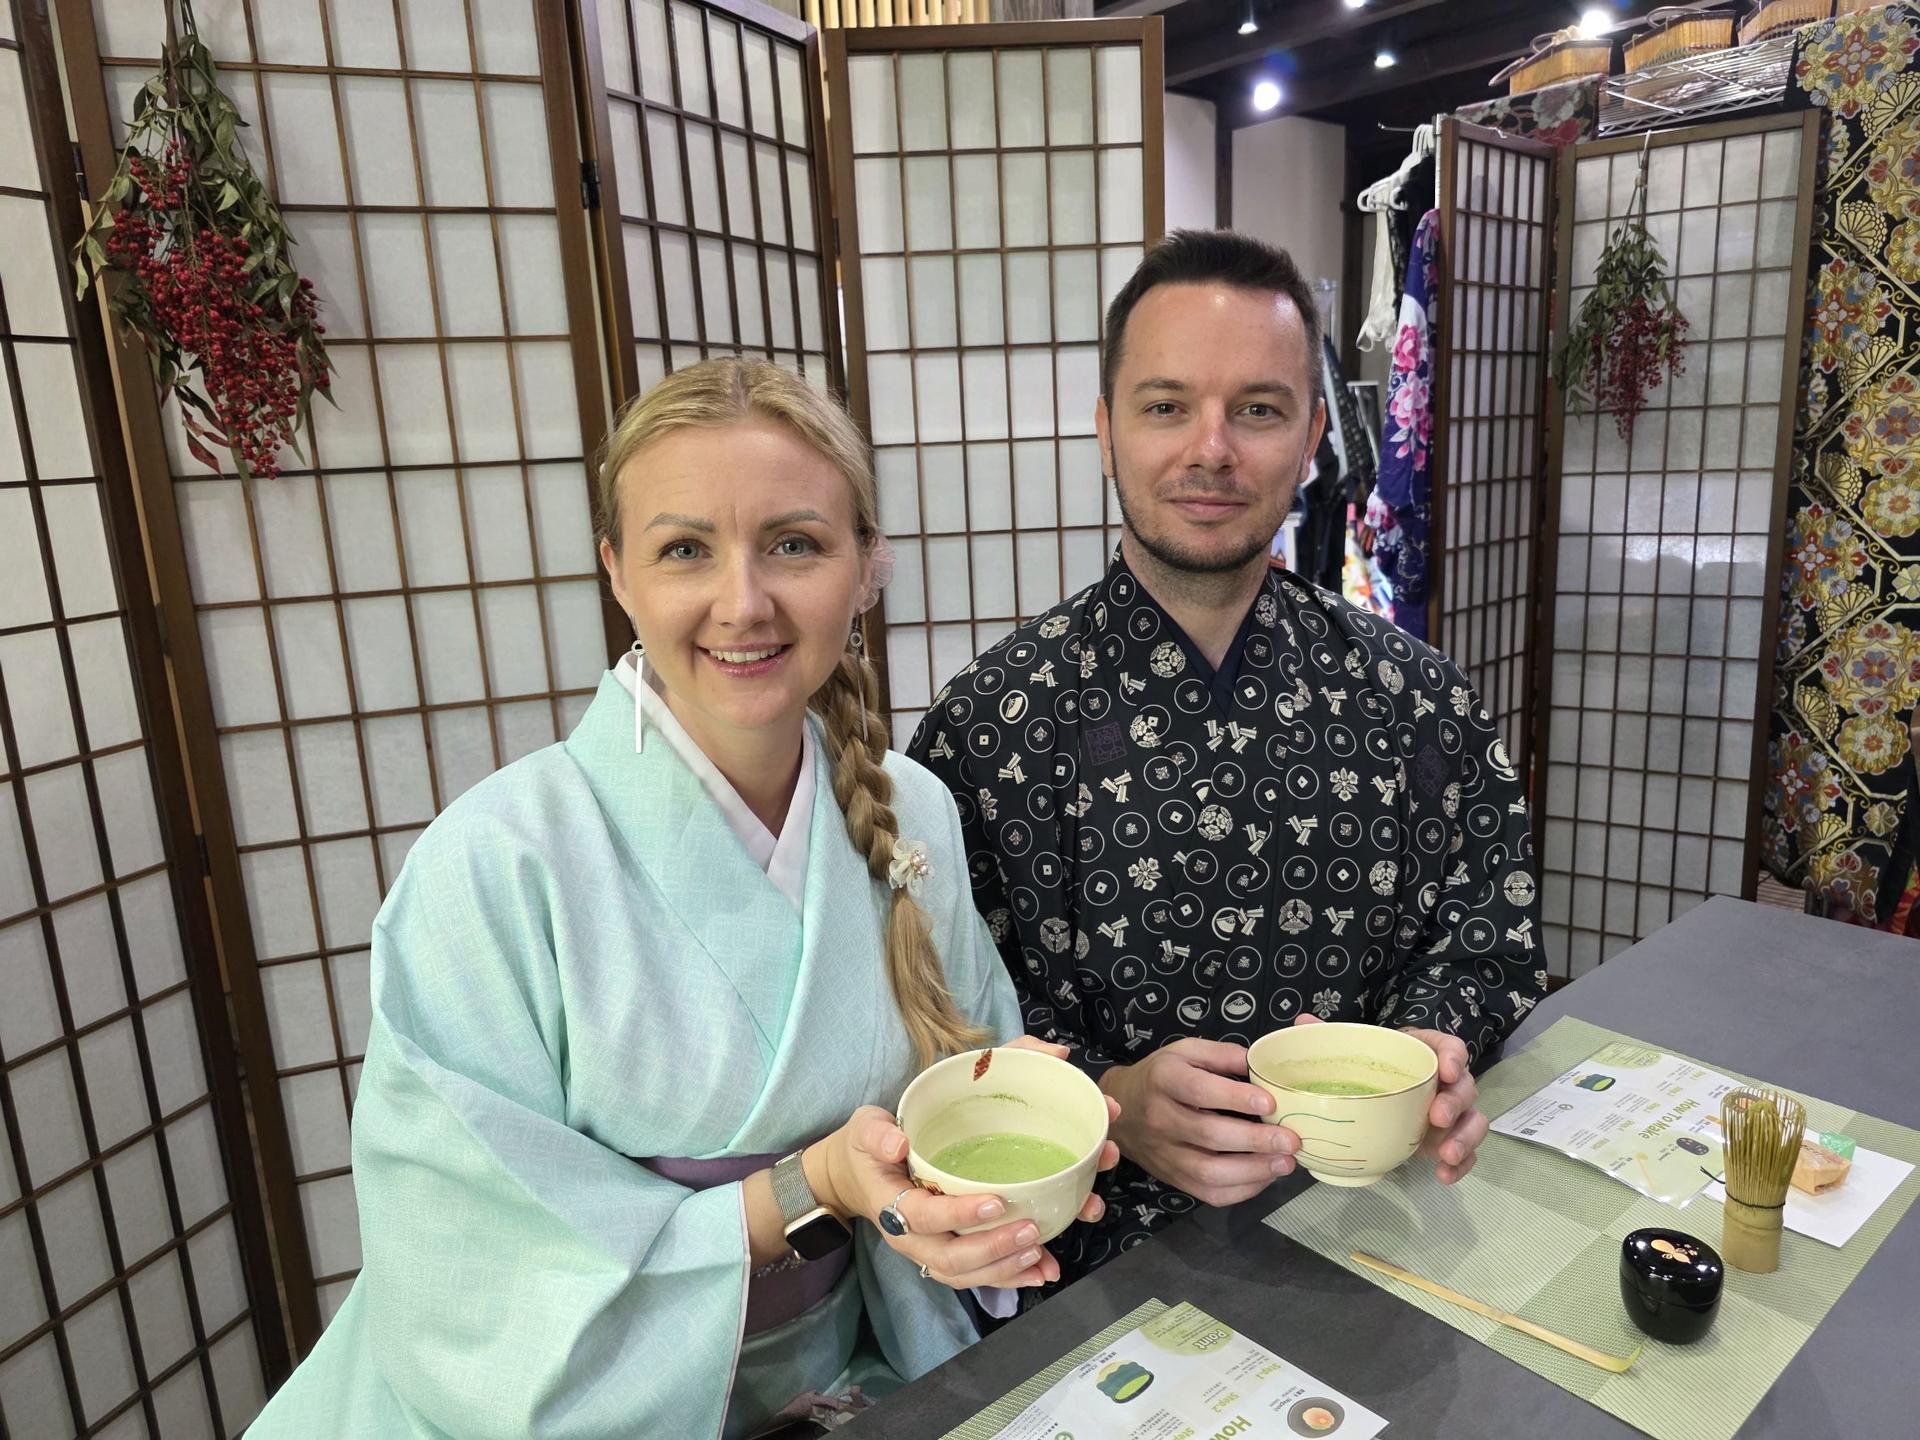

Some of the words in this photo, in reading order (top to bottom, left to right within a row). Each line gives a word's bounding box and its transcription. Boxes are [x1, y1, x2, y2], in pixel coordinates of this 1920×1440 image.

[1673, 1098, 1701, 1115] How
[1662, 1112, 1682, 1123] To
[1638, 1120, 1670, 1139] Make
[1193, 1329, 1228, 1350] Point
[1211, 1392, 1239, 1413] Step.2
